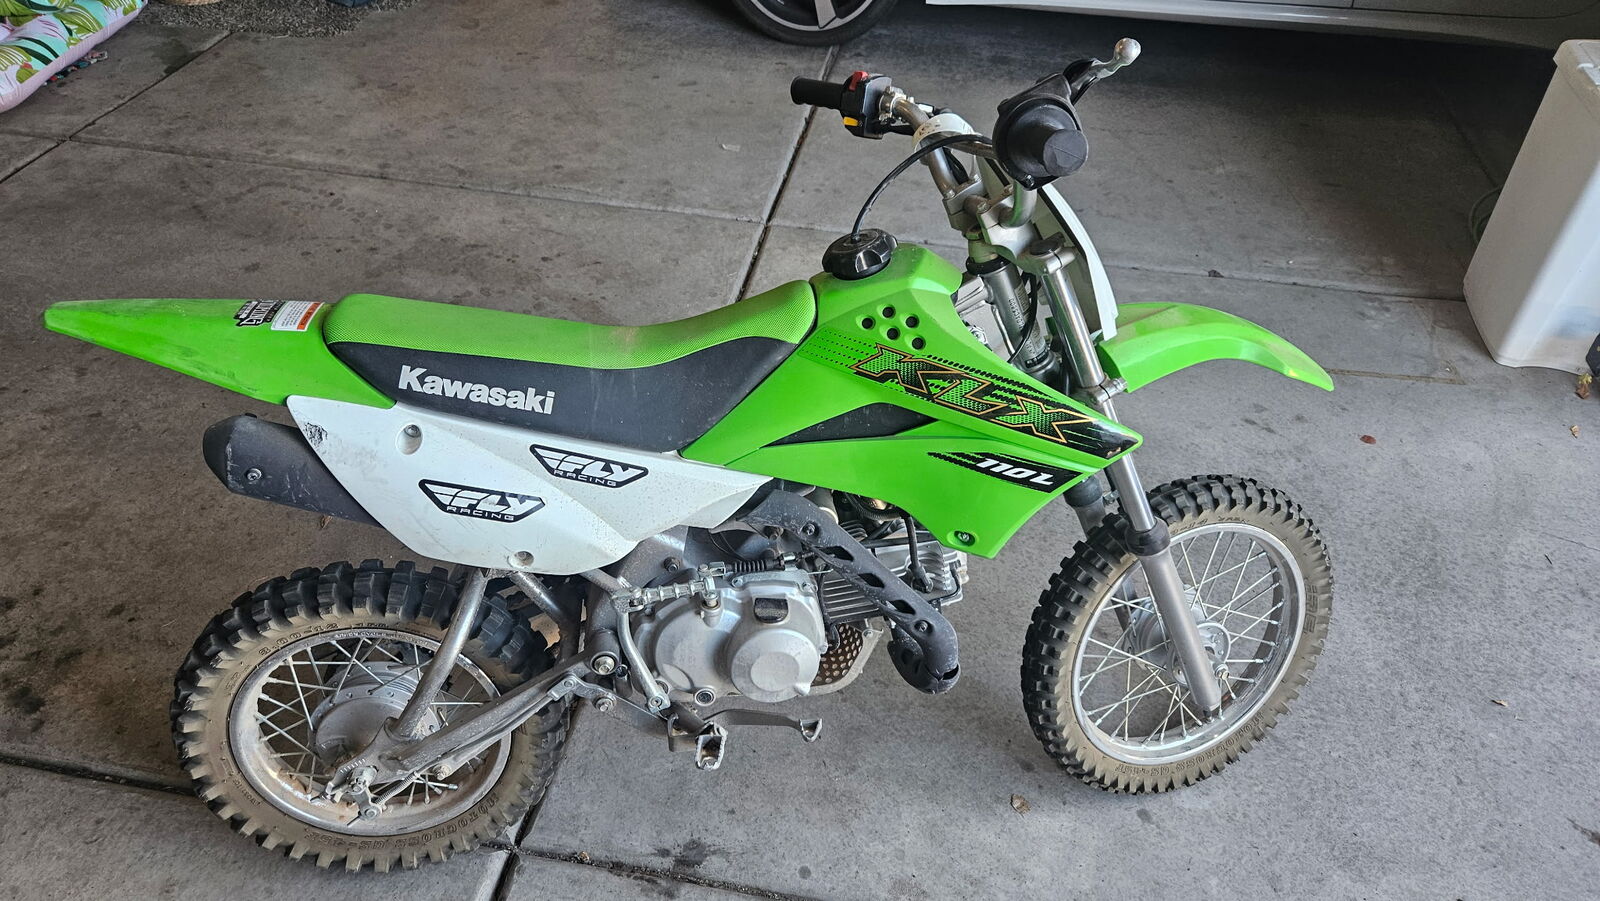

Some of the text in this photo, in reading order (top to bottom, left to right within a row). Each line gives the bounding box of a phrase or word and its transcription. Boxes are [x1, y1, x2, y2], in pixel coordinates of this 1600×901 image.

[398, 365, 556, 415] Kawasaki
[850, 343, 1099, 443] KLX
[536, 447, 646, 481] FLY
[553, 469, 618, 487] RACING
[976, 458, 1054, 486] 110L
[426, 483, 541, 515] FLY
[446, 505, 515, 522] RACING
